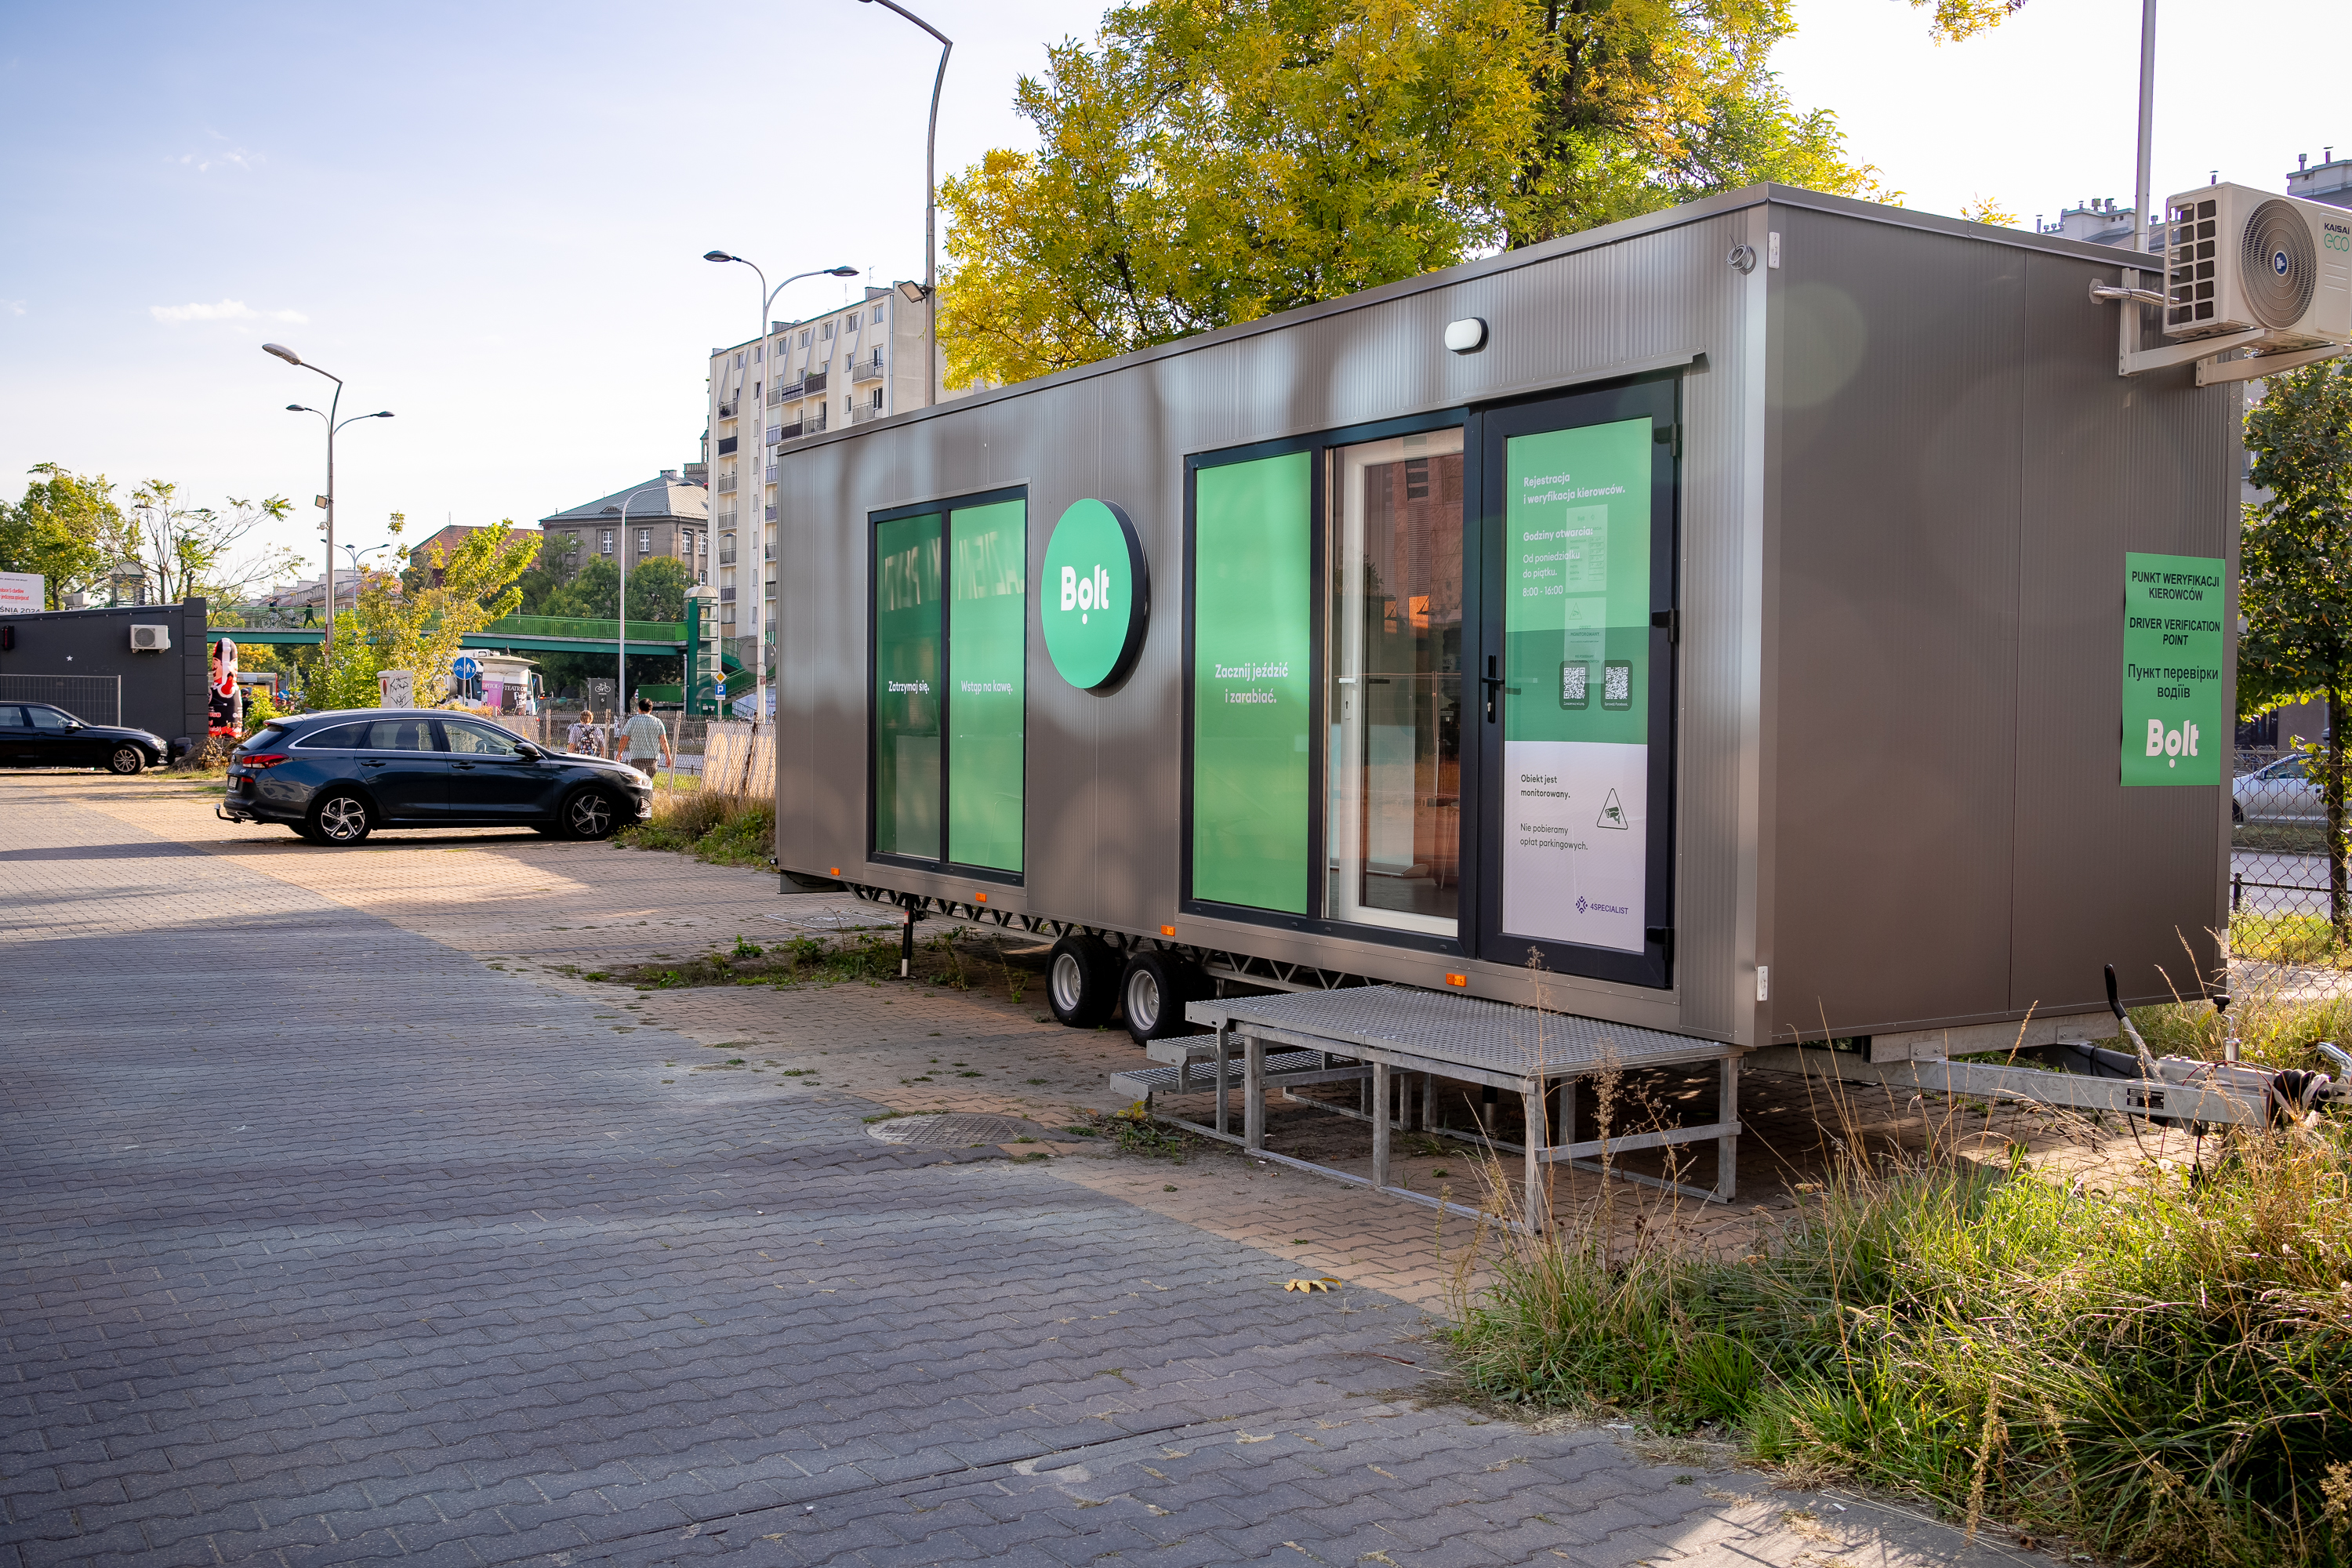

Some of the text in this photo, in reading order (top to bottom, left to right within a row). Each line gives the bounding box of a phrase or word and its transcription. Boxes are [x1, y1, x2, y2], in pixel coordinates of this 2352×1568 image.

[2324, 223, 2350, 235] KAISAI
[2324, 233, 2350, 252] eco
[1523, 472, 1570, 488] Rejestracja
[1523, 483, 1626, 505] i weryfikacja kierowców.
[1523, 526, 1593, 542] Godziny otwarcia:
[1523, 550, 1581, 564] Od poniedziałku
[1523, 567, 1557, 579] do piątku.
[2132, 571, 2220, 587] PUNKT WERYFIKACJI
[1061, 564, 1109, 625] Bolt
[1523, 586, 1538, 597] 8:00
[1544, 585, 1563, 595] 16:00
[2149, 587, 2203, 601] KIEROWCÓW
[2129, 617, 2220, 632] DRIVER VERIFICATION
[2163, 634, 2188, 646] POINT
[1214, 662, 1288, 682] Zacznij jeździć
[2128, 663, 2219, 682] Пункт перевірки
[717, 685, 724, 694] P
[888, 680, 930, 695] Zatrzymaj się.
[960, 680, 1013, 695] Wstąp na kawę.
[2157, 684, 2190, 700] водіїв
[1225, 688, 1277, 703] i zarabiać.
[2146, 719, 2199, 768] Bolt
[1520, 774, 1557, 786] Obiekt jest
[1520, 788, 1570, 800] monitorowany.
[1520, 822, 1569, 837] Nie pobieramy
[1519, 837, 1588, 851] opłat parkingowych.
[1590, 903, 1628, 915] 4SPECIALIST
